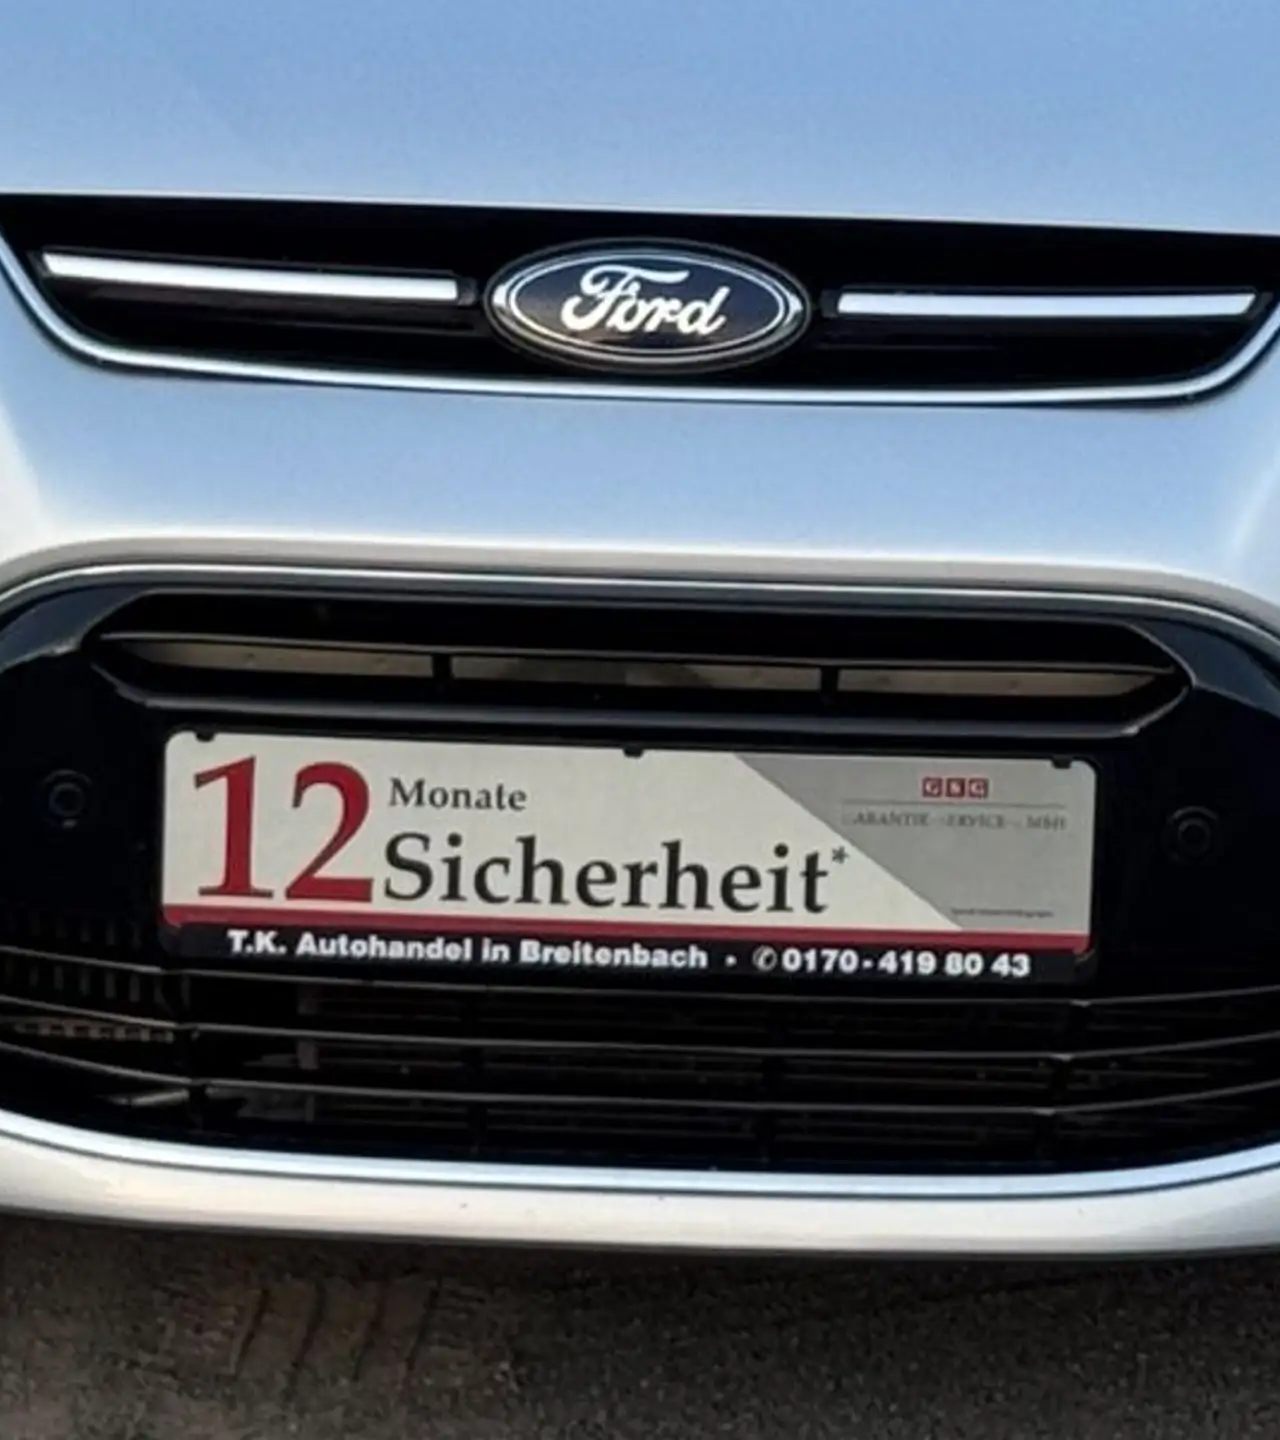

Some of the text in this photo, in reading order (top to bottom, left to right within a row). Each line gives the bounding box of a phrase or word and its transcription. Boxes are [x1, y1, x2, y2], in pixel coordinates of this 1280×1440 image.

[561, 264, 730, 335] Ford
[388, 777, 528, 811] Monate
[193, 755, 374, 903] 12
[227, 929, 287, 955] T.K.
[296, 932, 472, 961] Autohandel
[482, 937, 510, 962] in
[519, 939, 709, 969] Breitenbach
[944, 953, 983, 977] 80
[991, 953, 1032, 978] 43
